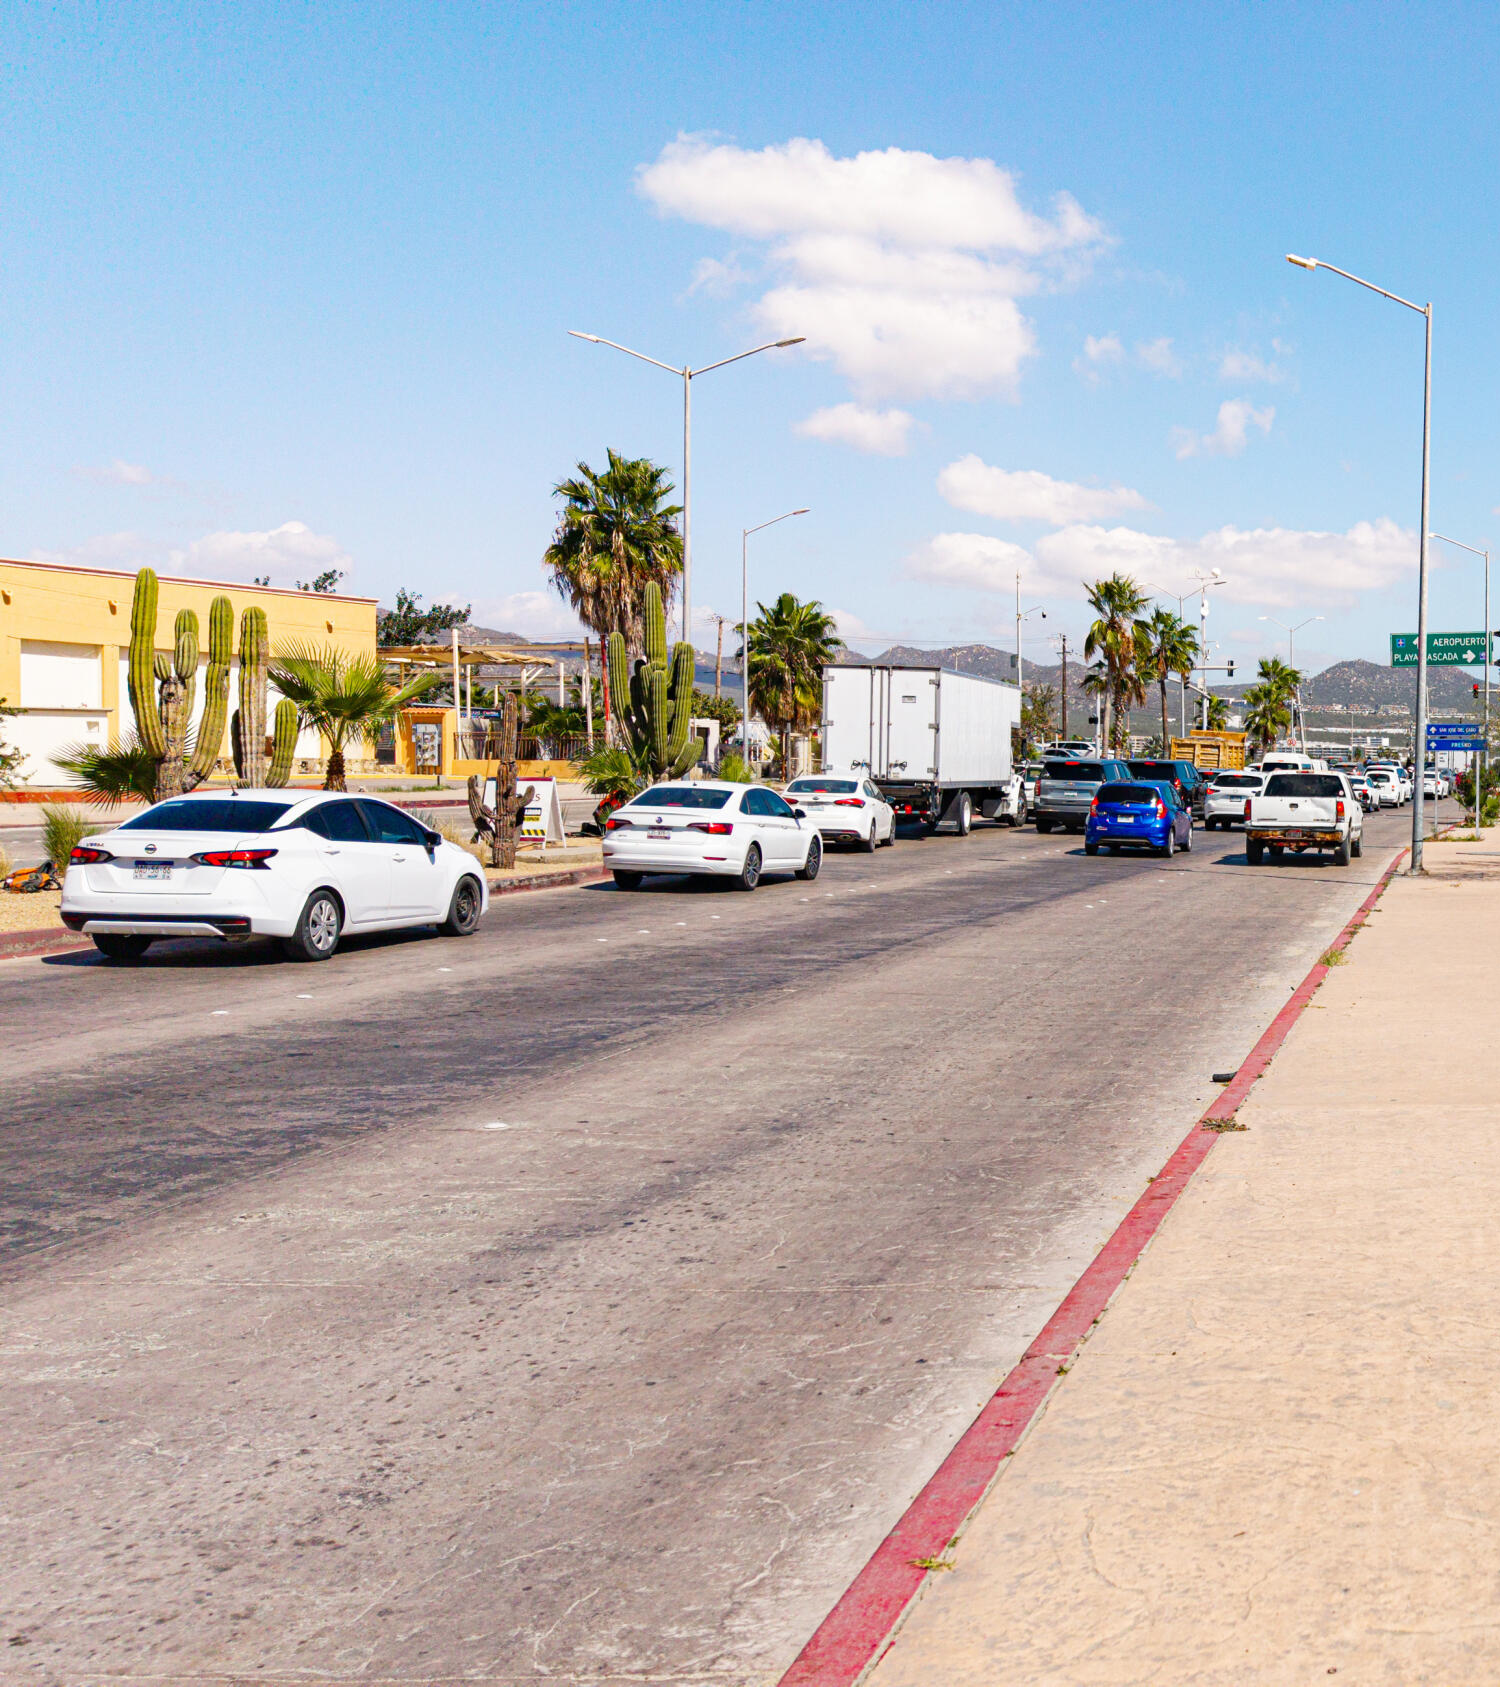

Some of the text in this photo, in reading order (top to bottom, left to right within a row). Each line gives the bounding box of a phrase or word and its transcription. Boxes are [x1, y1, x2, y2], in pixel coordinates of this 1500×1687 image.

[1433, 637, 1486, 647] AEROPUERTO
[1394, 652, 1458, 662] PLAYA ASCADA
